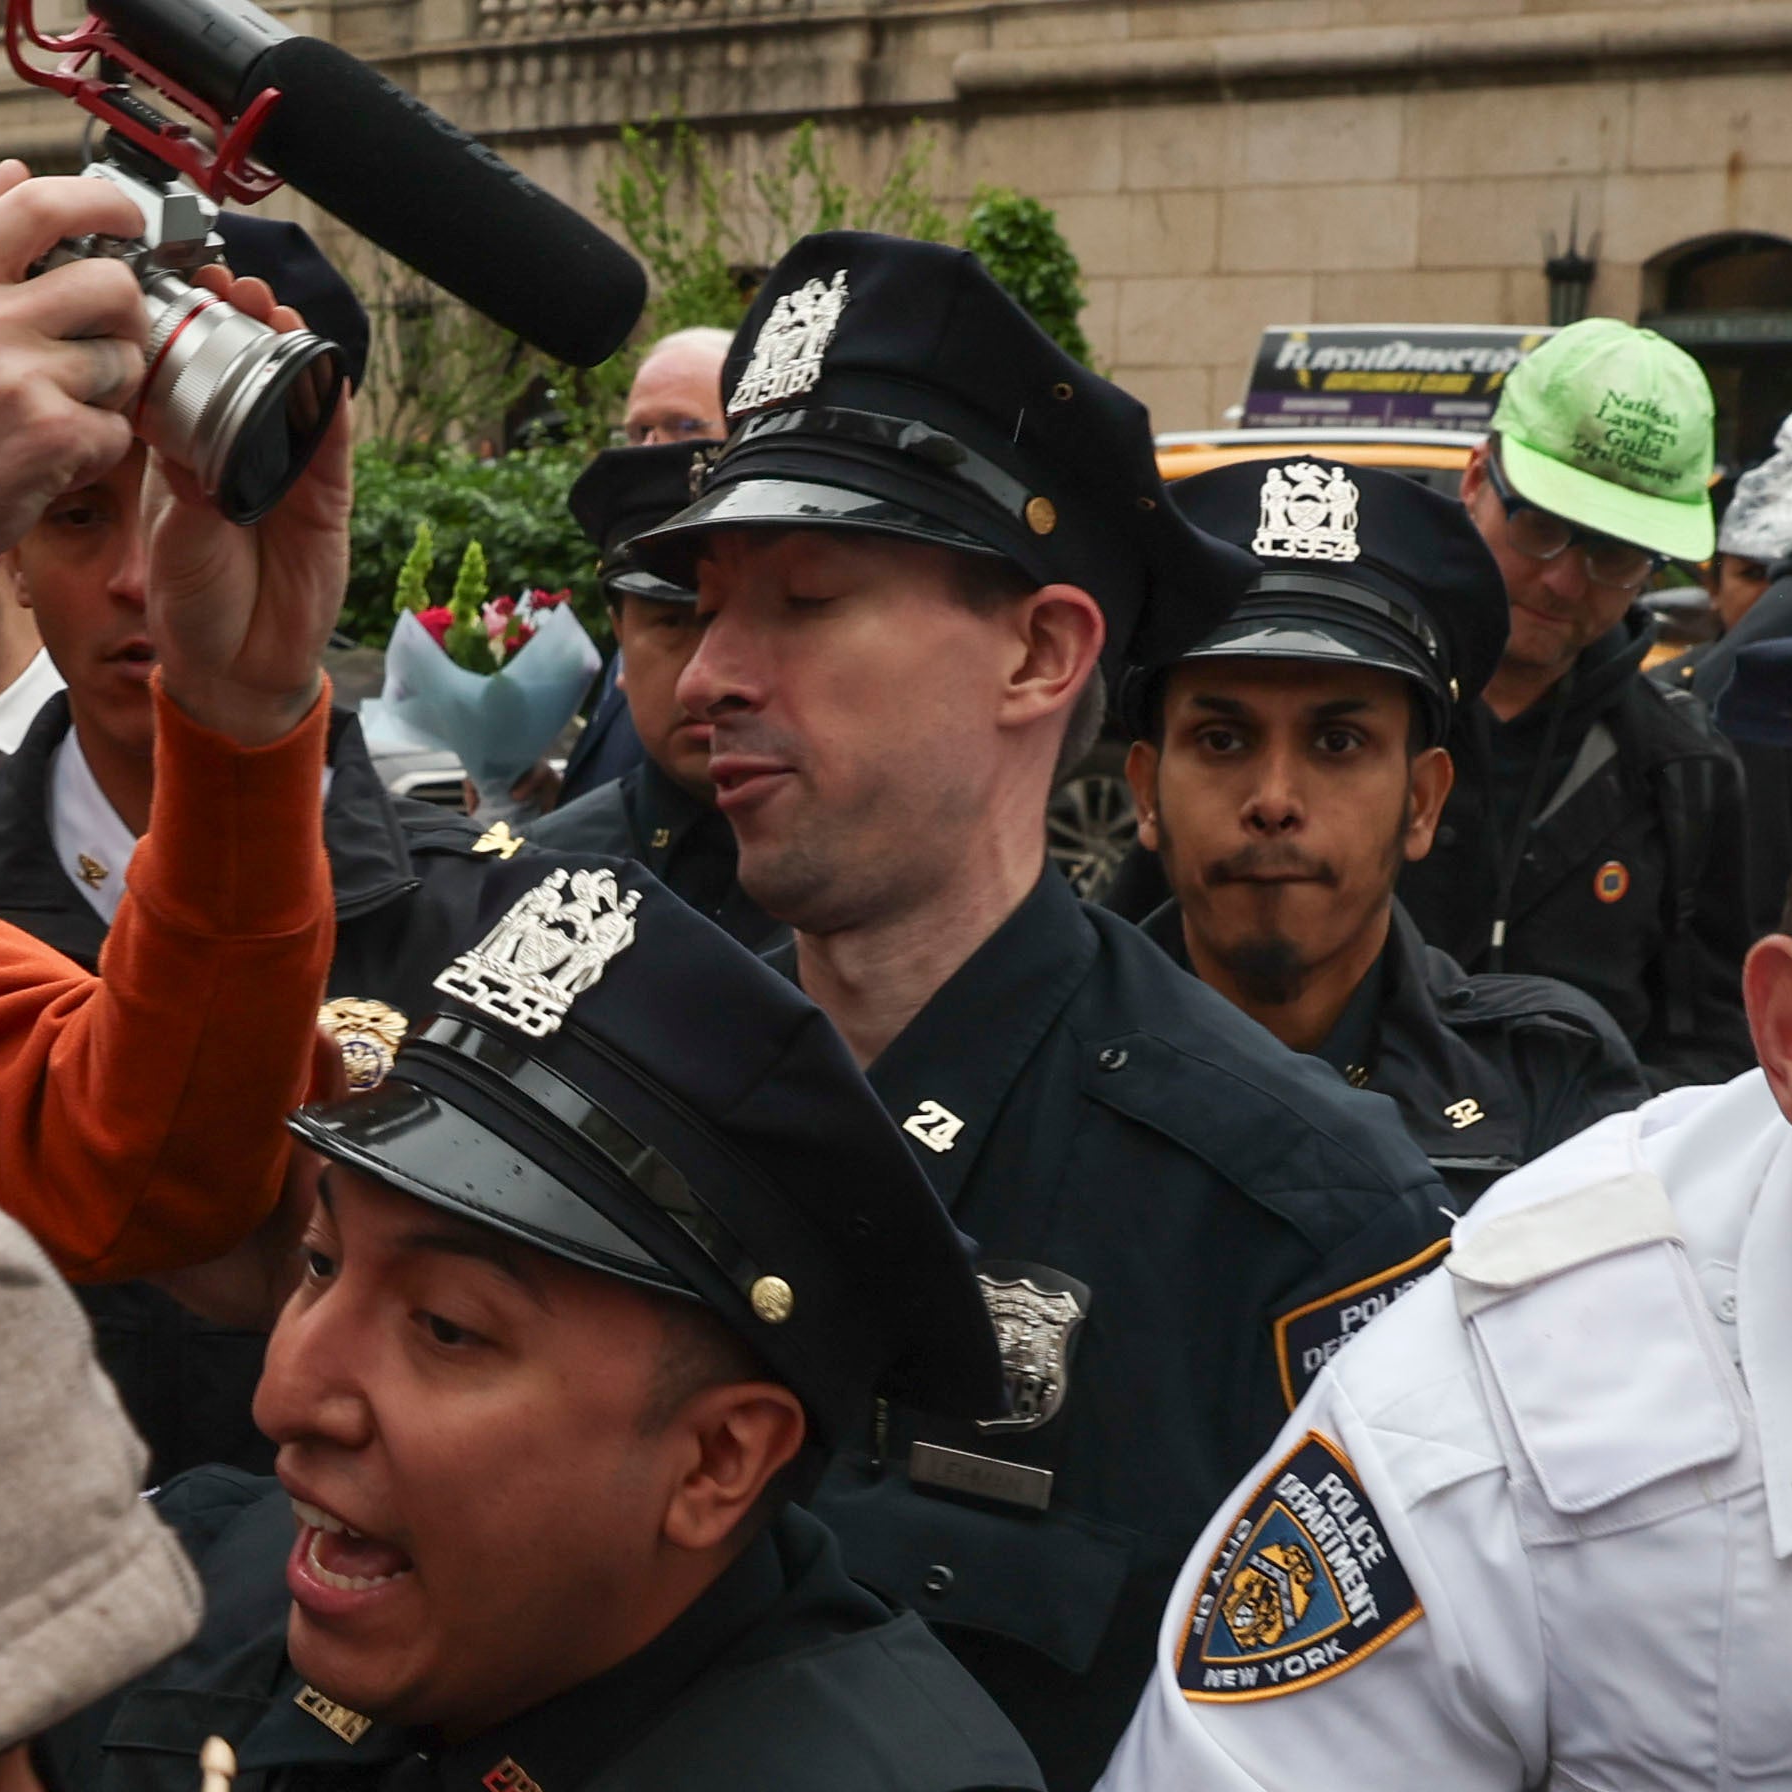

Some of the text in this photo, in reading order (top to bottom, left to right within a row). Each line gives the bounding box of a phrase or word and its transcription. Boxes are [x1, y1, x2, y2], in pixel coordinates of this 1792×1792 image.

[1606, 429, 1663, 460] Guild
[902, 1100, 965, 1153] 24
[1444, 1098, 1485, 1129] 32
[1314, 1472, 1387, 1570] POLICE
[1211, 1518, 1253, 1586] CITY
[1275, 1472, 1379, 1628] DEPARTMENT
[1203, 1637, 1349, 1688] NEW YORK
